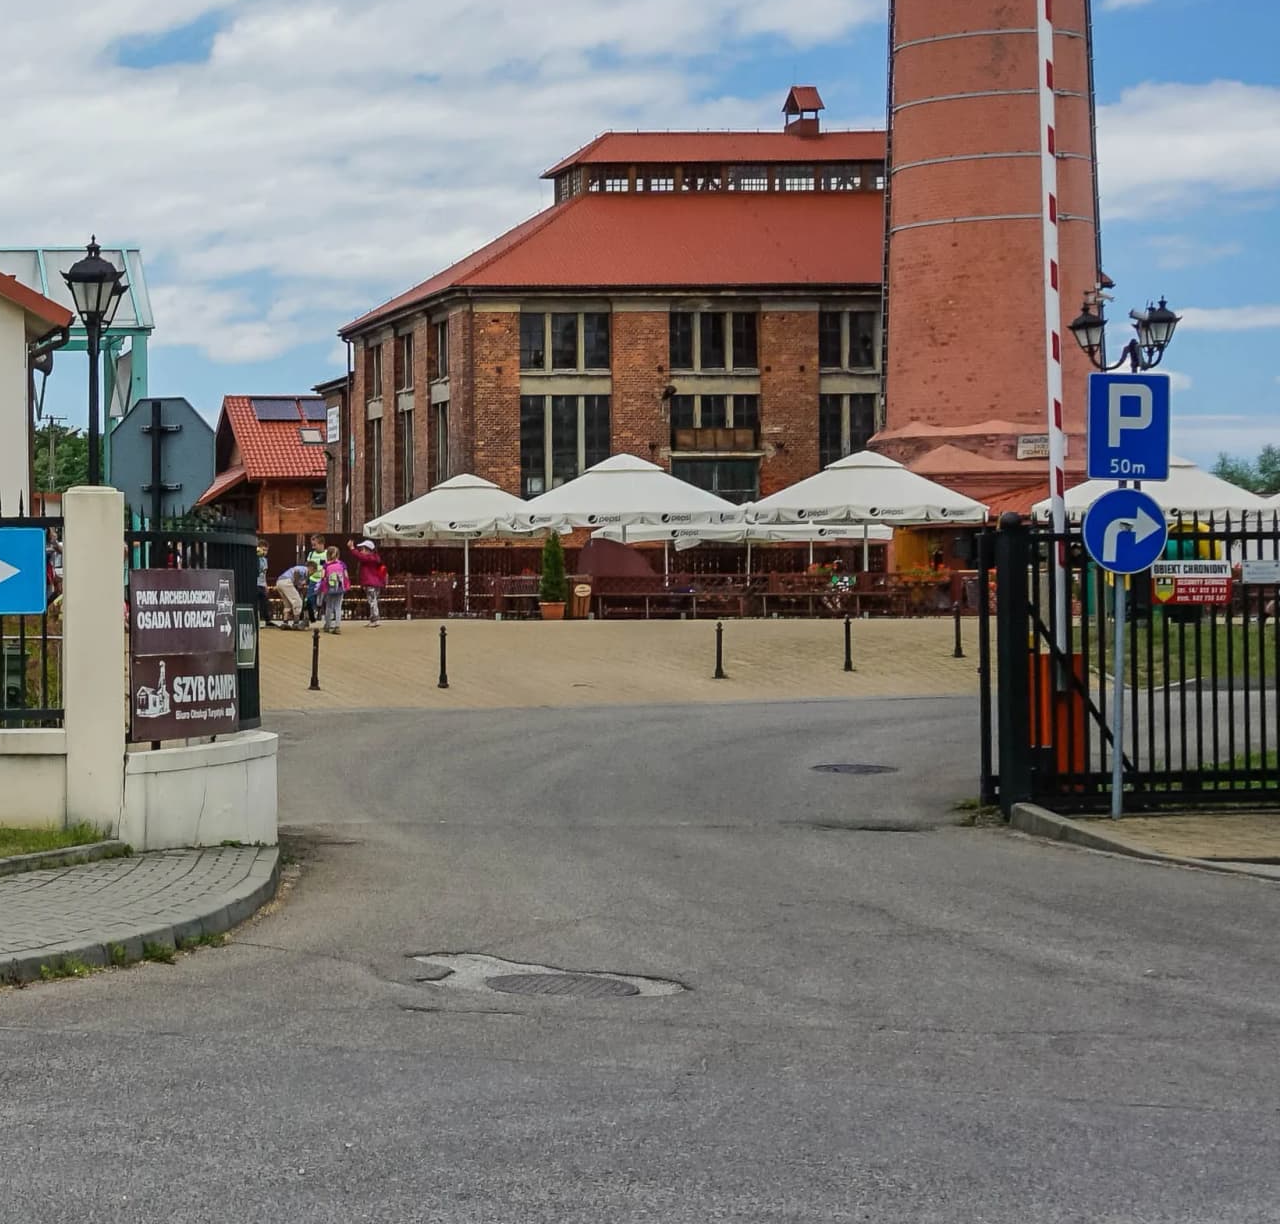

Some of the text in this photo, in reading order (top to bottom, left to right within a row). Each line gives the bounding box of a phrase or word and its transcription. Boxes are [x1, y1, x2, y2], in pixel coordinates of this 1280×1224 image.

[1108, 382, 1153, 448] P
[1110, 458, 1146, 475] 50m
[1153, 563, 1228, 574] OBIEKT CHRONIONY
[136, 590, 216, 605] PARK ARCHEOLOGICZNY
[137, 610, 216, 630] OSADA VI ORACZY
[173, 673, 237, 703] SZYB CAMPI
